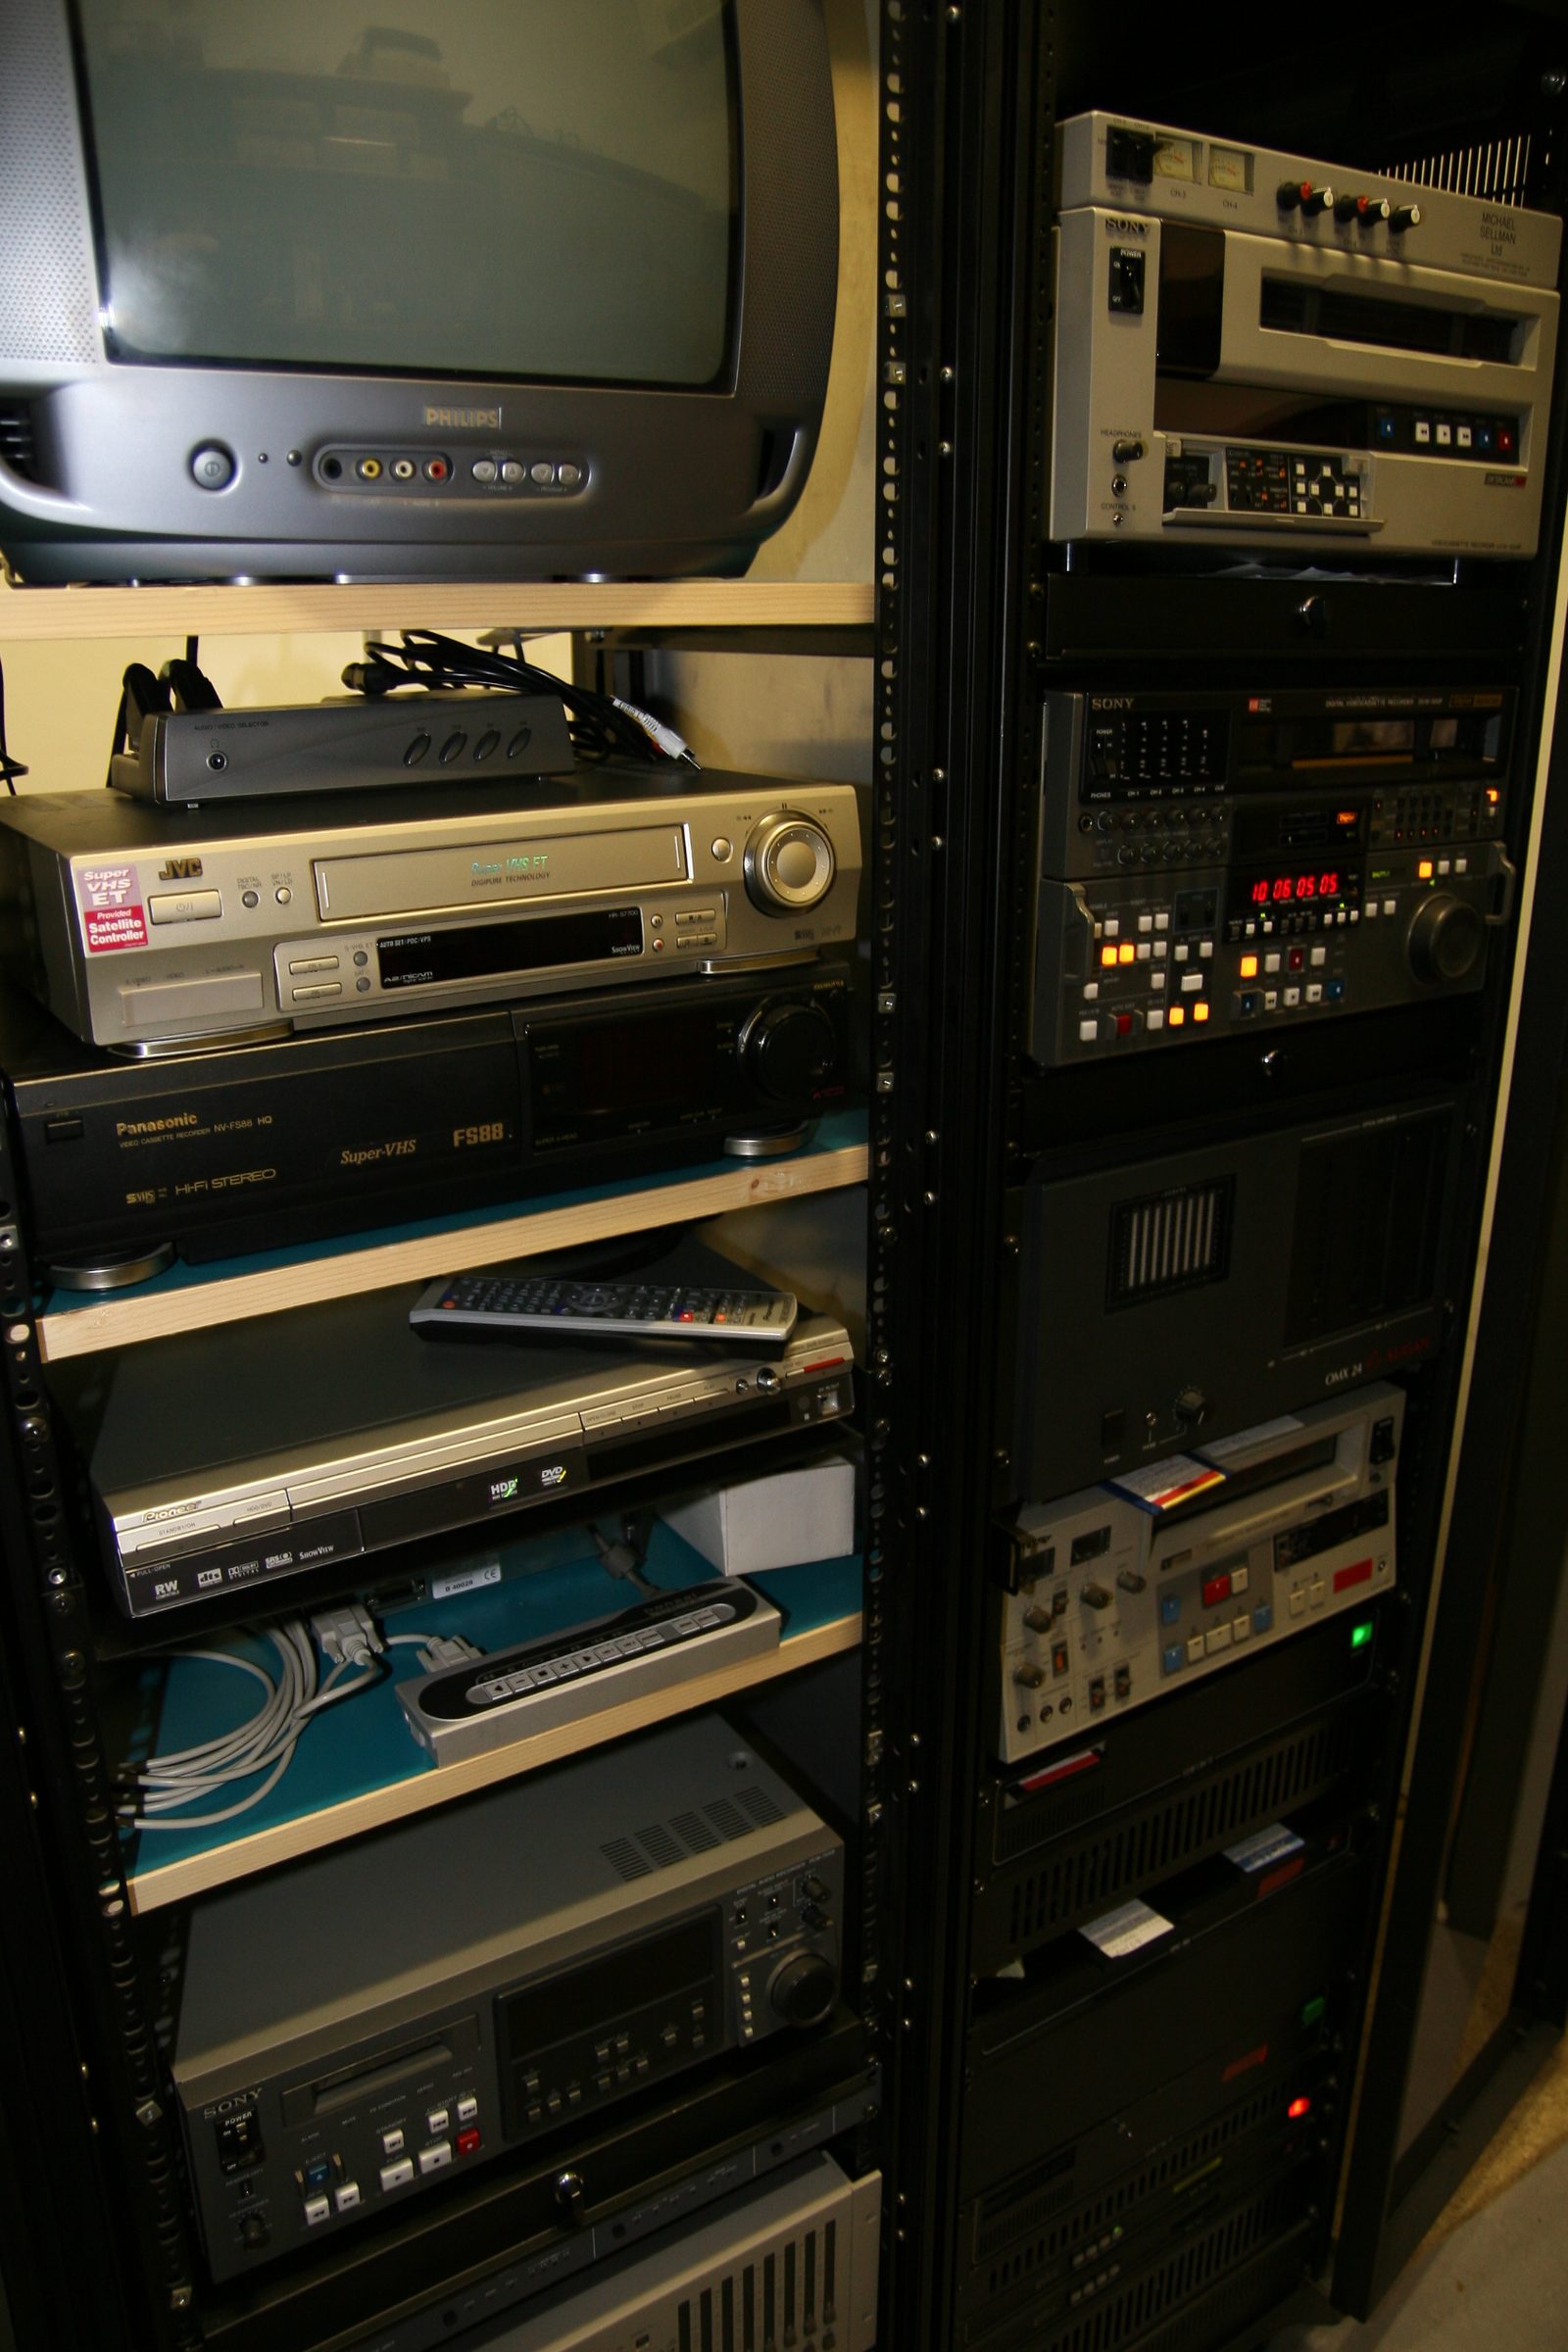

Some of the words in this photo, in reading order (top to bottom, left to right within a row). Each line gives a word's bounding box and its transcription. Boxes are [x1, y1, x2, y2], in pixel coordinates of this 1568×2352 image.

[1105, 218, 1148, 233] SONY
[1482, 212, 1515, 230] MICHAEL
[1480, 225, 1516, 244] SELLMAN
[1120, 249, 1142, 259] POWER
[425, 408, 498, 428] PHILIPS
[1101, 429, 1142, 439] HEADPHONES
[1101, 503, 1130, 512] CONTROL
[1092, 698, 1135, 710] SONY
[159, 858, 204, 881] JVC
[505, 857, 529, 871] VHS
[83, 868, 129, 881] Super
[471, 877, 503, 887] DIGIPURE
[506, 872, 551, 884] TECHNOLOGY
[86, 878, 131, 893] VHS
[1251, 879, 1269, 904] 10
[92, 891, 126, 906] ET
[97, 908, 132, 920] Provided
[88, 918, 142, 935] Satellite
[90, 930, 144, 946] Controller
[116, 1111, 199, 1137] Panasonic
[120, 1139, 139, 1149] VIDEO
[140, 1133, 175, 1146] CASSETTE
[175, 1127, 212, 1139] RECORDER
[214, 1119, 254, 1134] NV-FS88
[257, 1115, 273, 1126] HQ
[452, 1123, 505, 1148] FS88
[174, 1180, 209, 1197] HI-FI
[211, 1167, 277, 1190] STEREO
[541, 1465, 564, 1479] DVD
[490, 1478, 517, 1496] HDD
[141, 1501, 202, 1523] Pioneer
[158, 1522, 196, 1537] STANDBY/ON
[199, 1570, 221, 1584] dts
[155, 1579, 178, 1596] RW
[203, 2086, 264, 2120] SONY
[224, 2111, 253, 2127] POWER
